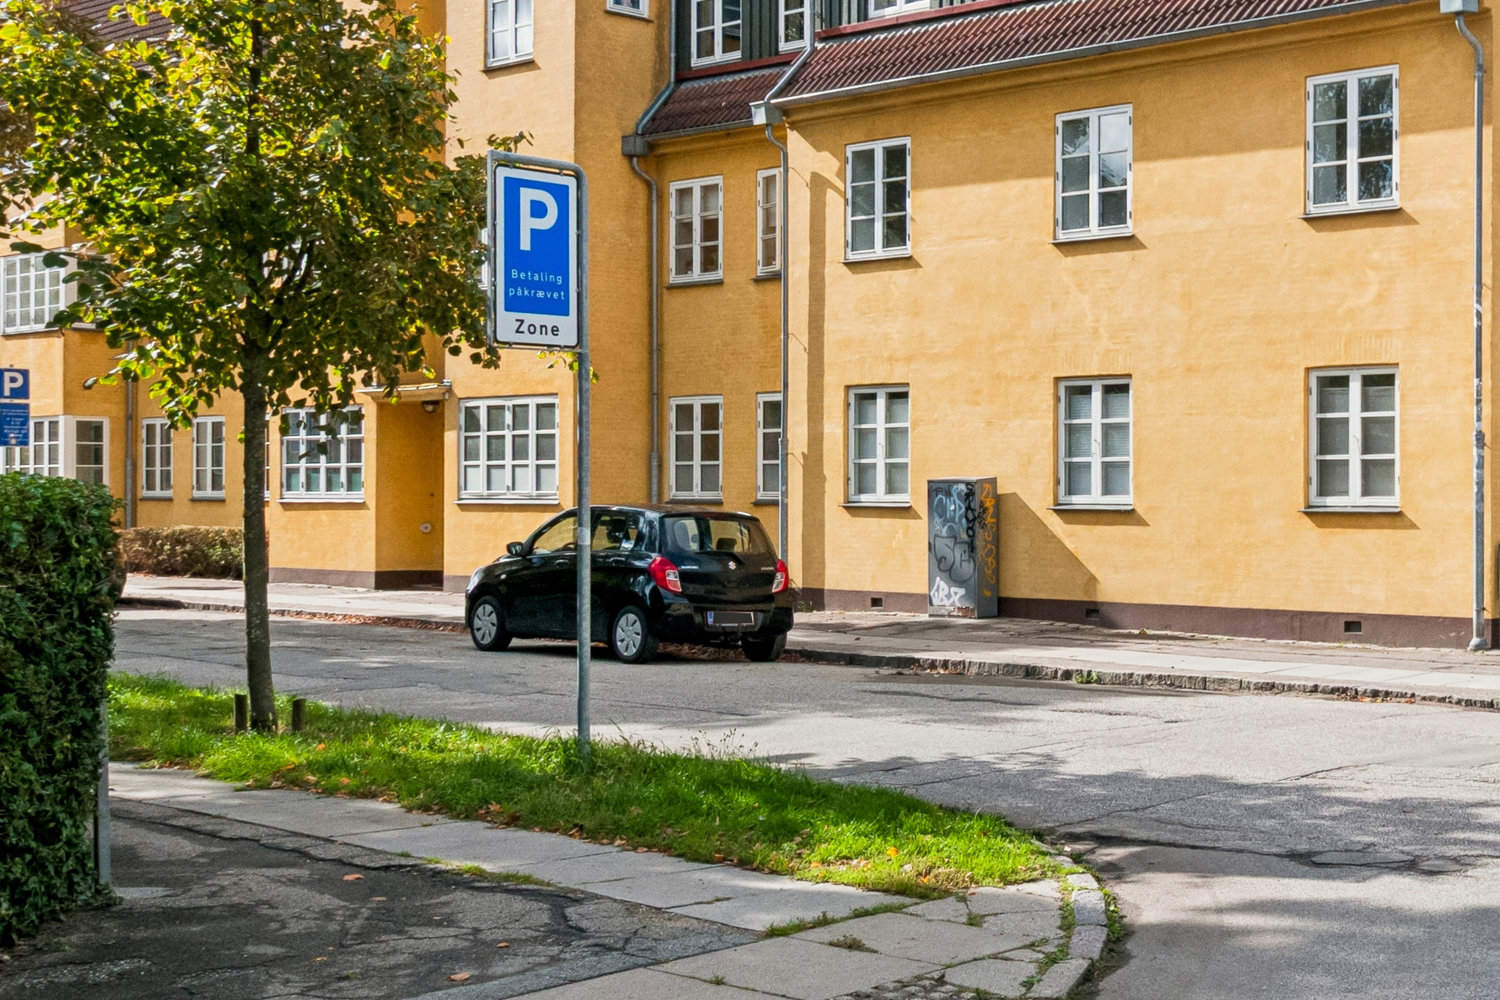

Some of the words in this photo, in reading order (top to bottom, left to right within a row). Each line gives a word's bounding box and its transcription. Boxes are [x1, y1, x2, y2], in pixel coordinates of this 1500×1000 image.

[519, 187, 559, 251] P
[511, 268, 563, 285] Betaling
[508, 286, 566, 300] påkrævet
[515, 318, 560, 337] Zone
[3, 371, 24, 397] P
